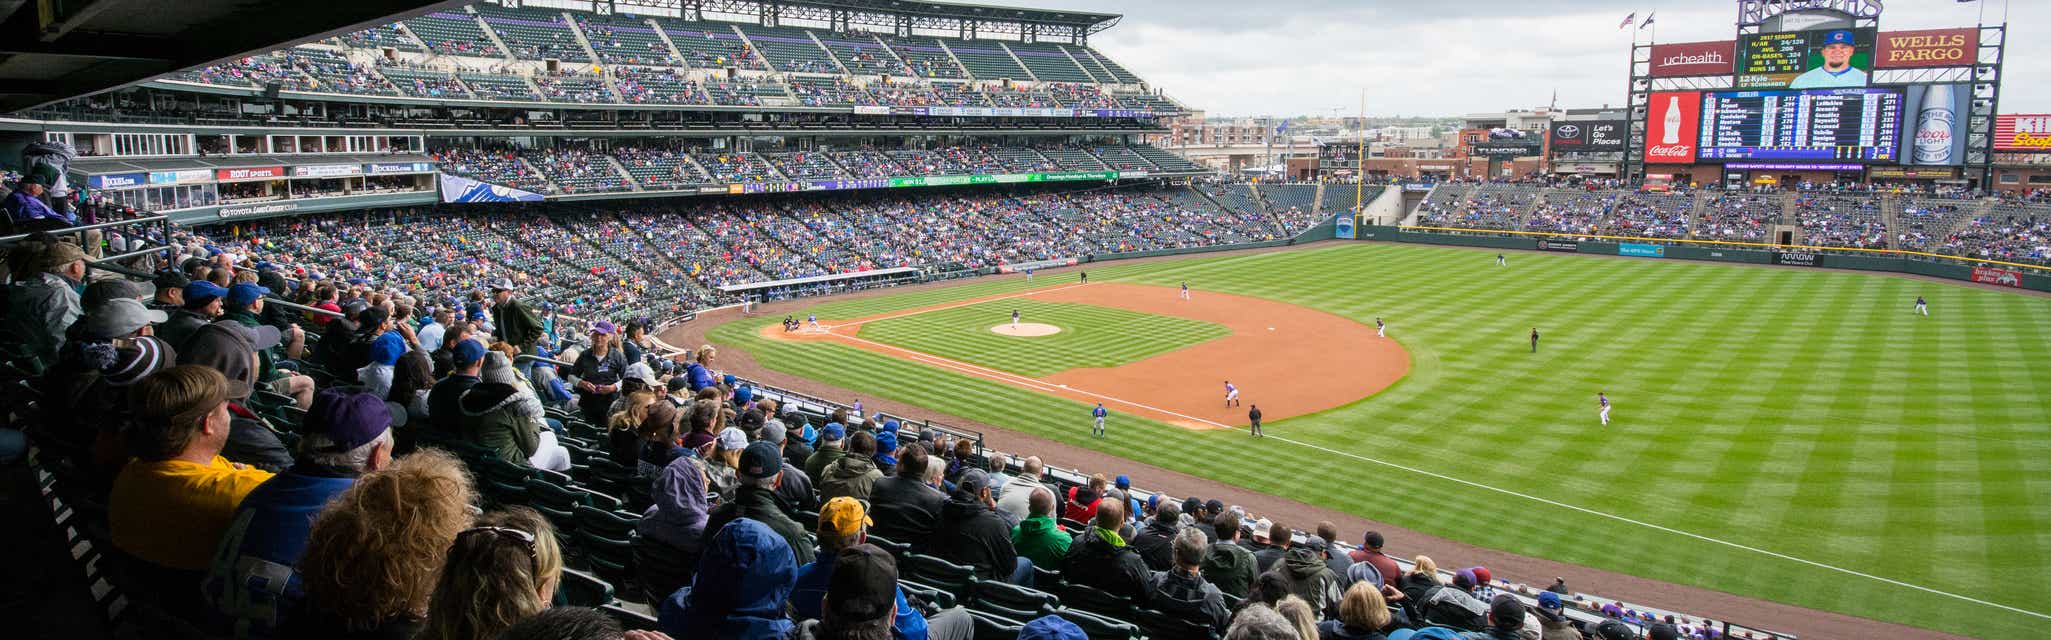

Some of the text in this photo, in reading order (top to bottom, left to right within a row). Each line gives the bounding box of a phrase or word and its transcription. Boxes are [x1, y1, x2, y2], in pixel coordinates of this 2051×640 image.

[1740, 0, 1883, 24] ROES
[1889, 34, 1965, 49] WELLS
[1664, 51, 1722, 66] uchealth
[1888, 48, 1963, 62] FARGO
[1593, 124, 1614, 132] Let's
[1916, 128, 1950, 139] Coors
[1649, 145, 1690, 157] Coca-Cola
[230, 169, 249, 179] ROOT
[230, 208, 252, 216] TOYOTA
